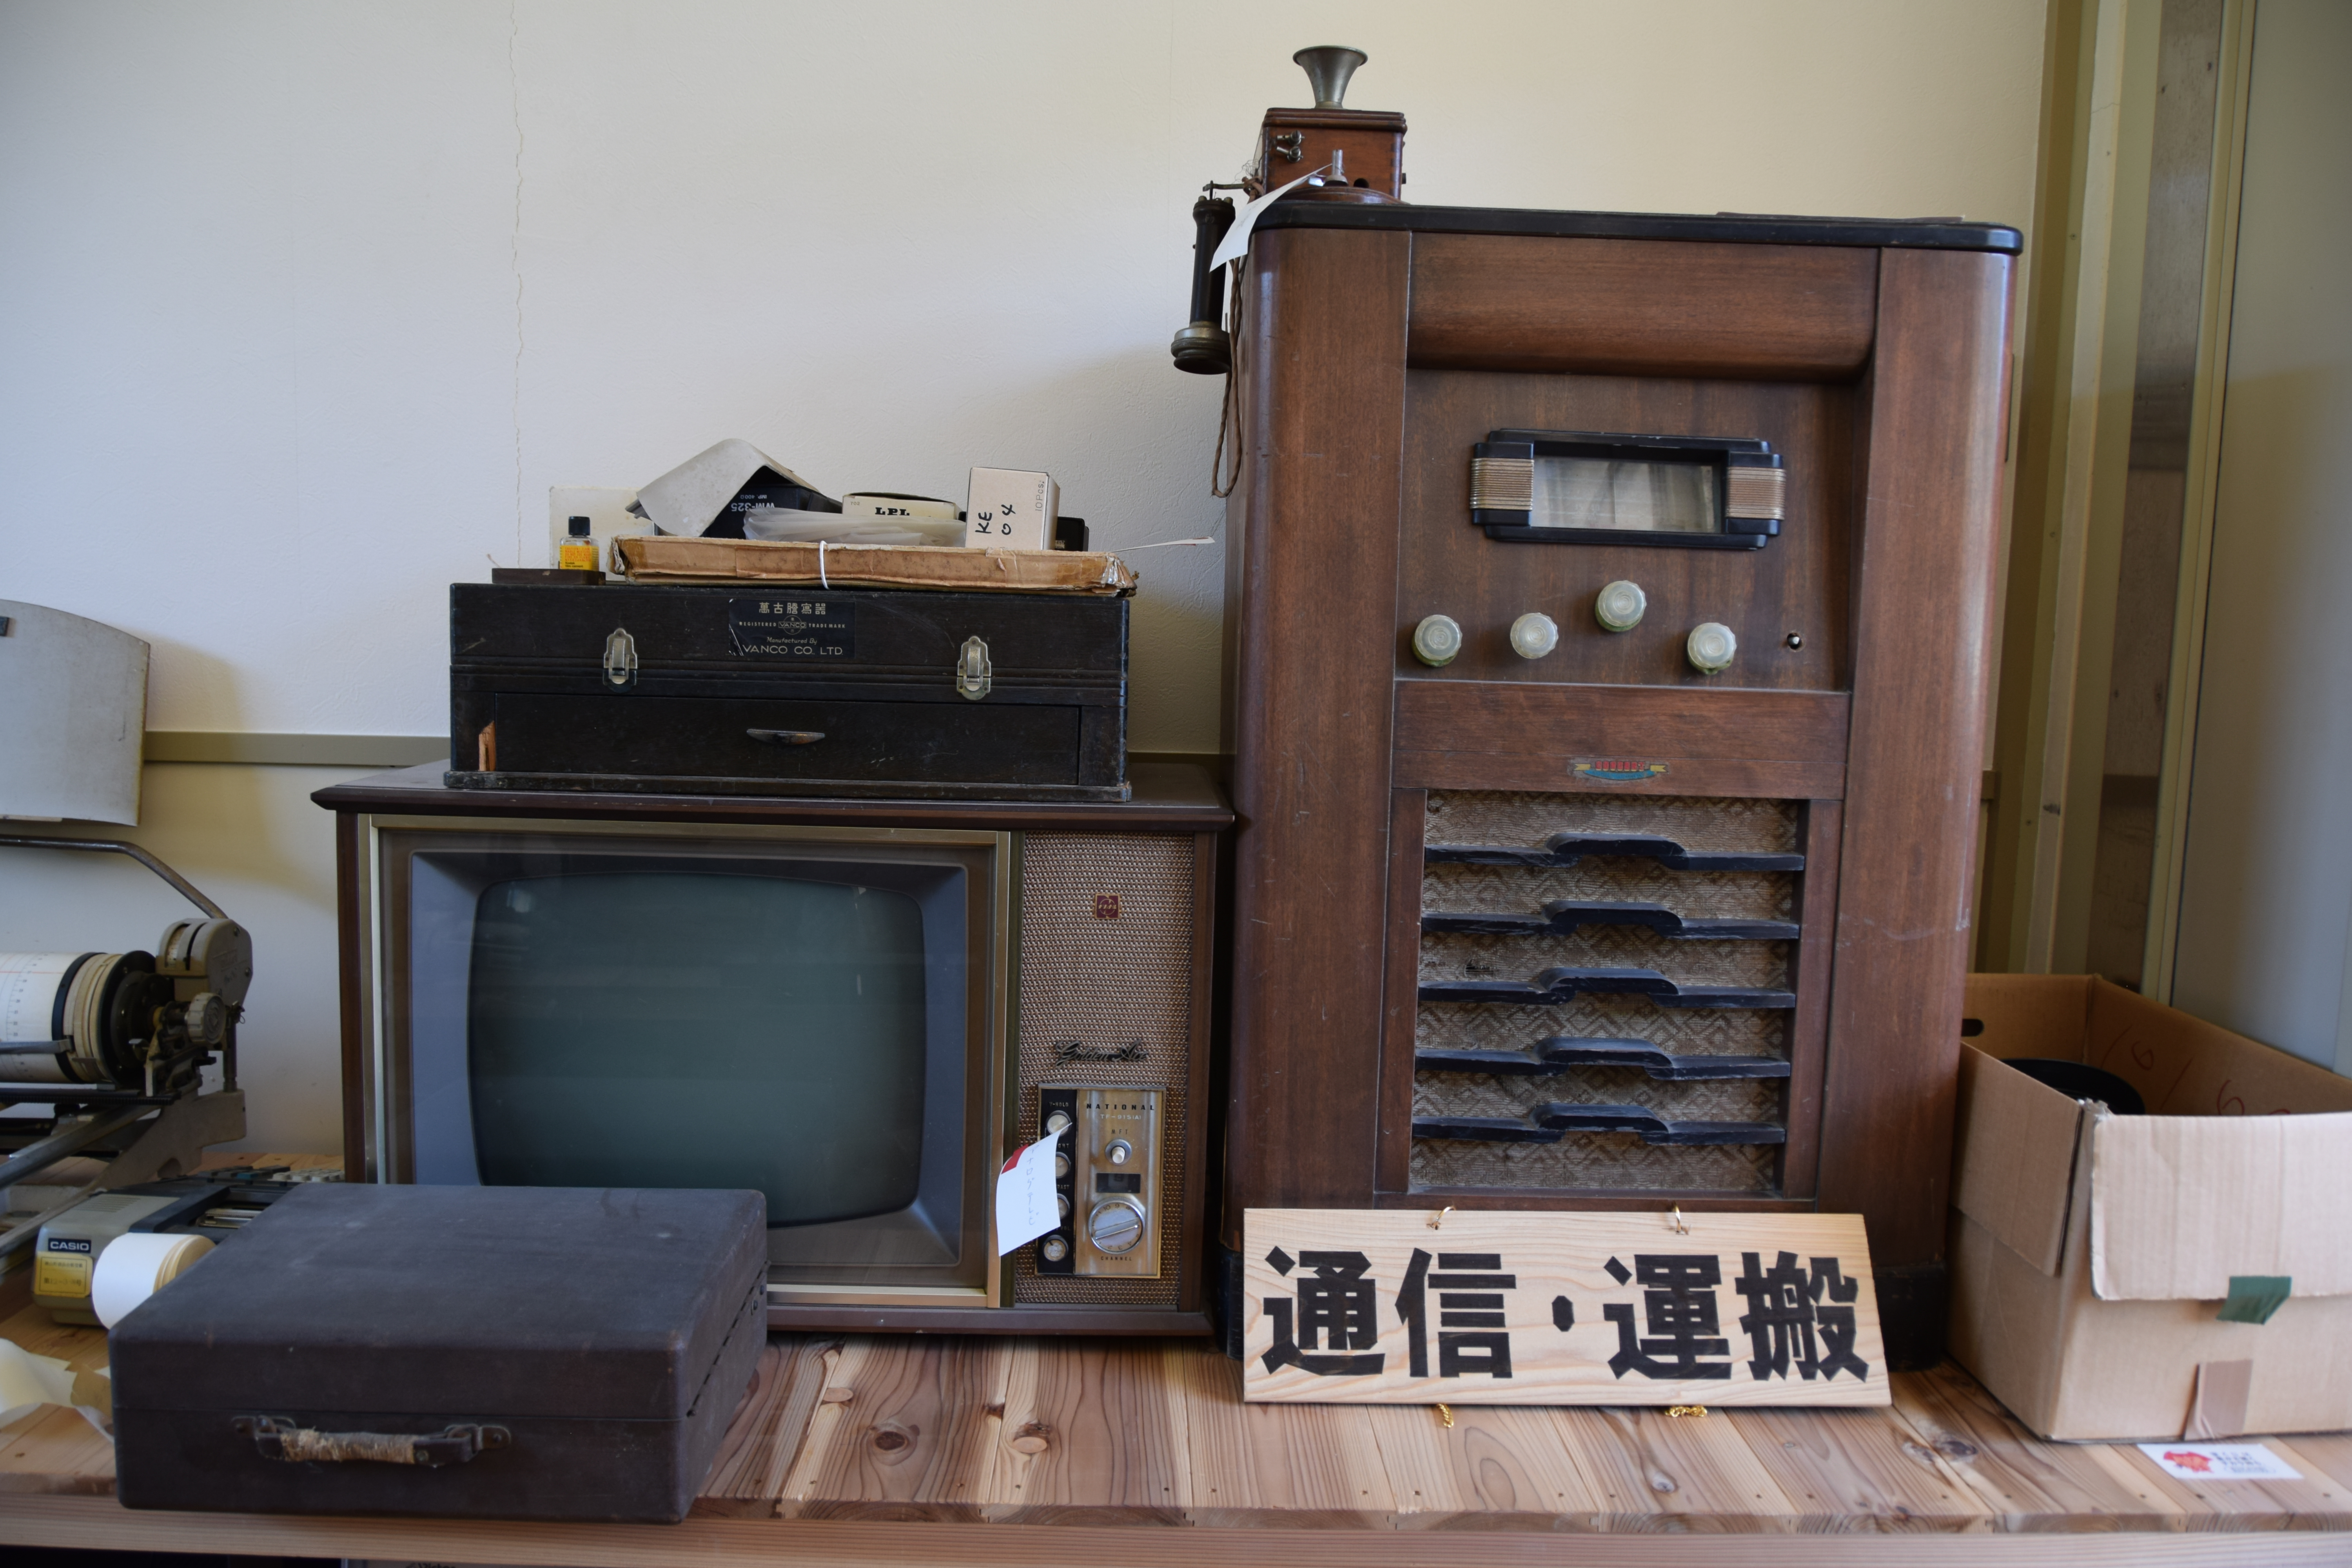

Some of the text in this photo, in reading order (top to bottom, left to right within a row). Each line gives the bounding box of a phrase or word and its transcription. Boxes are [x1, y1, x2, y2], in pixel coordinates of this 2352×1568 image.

[875, 507, 910, 516] LPL
[742, 644, 788, 654] VANCO
[1055, 1038, 1148, 1067] Golden Ace
[50, 1241, 89, 1251] CASIO
[1261, 1245, 1869, 1382] 通信・運搬
